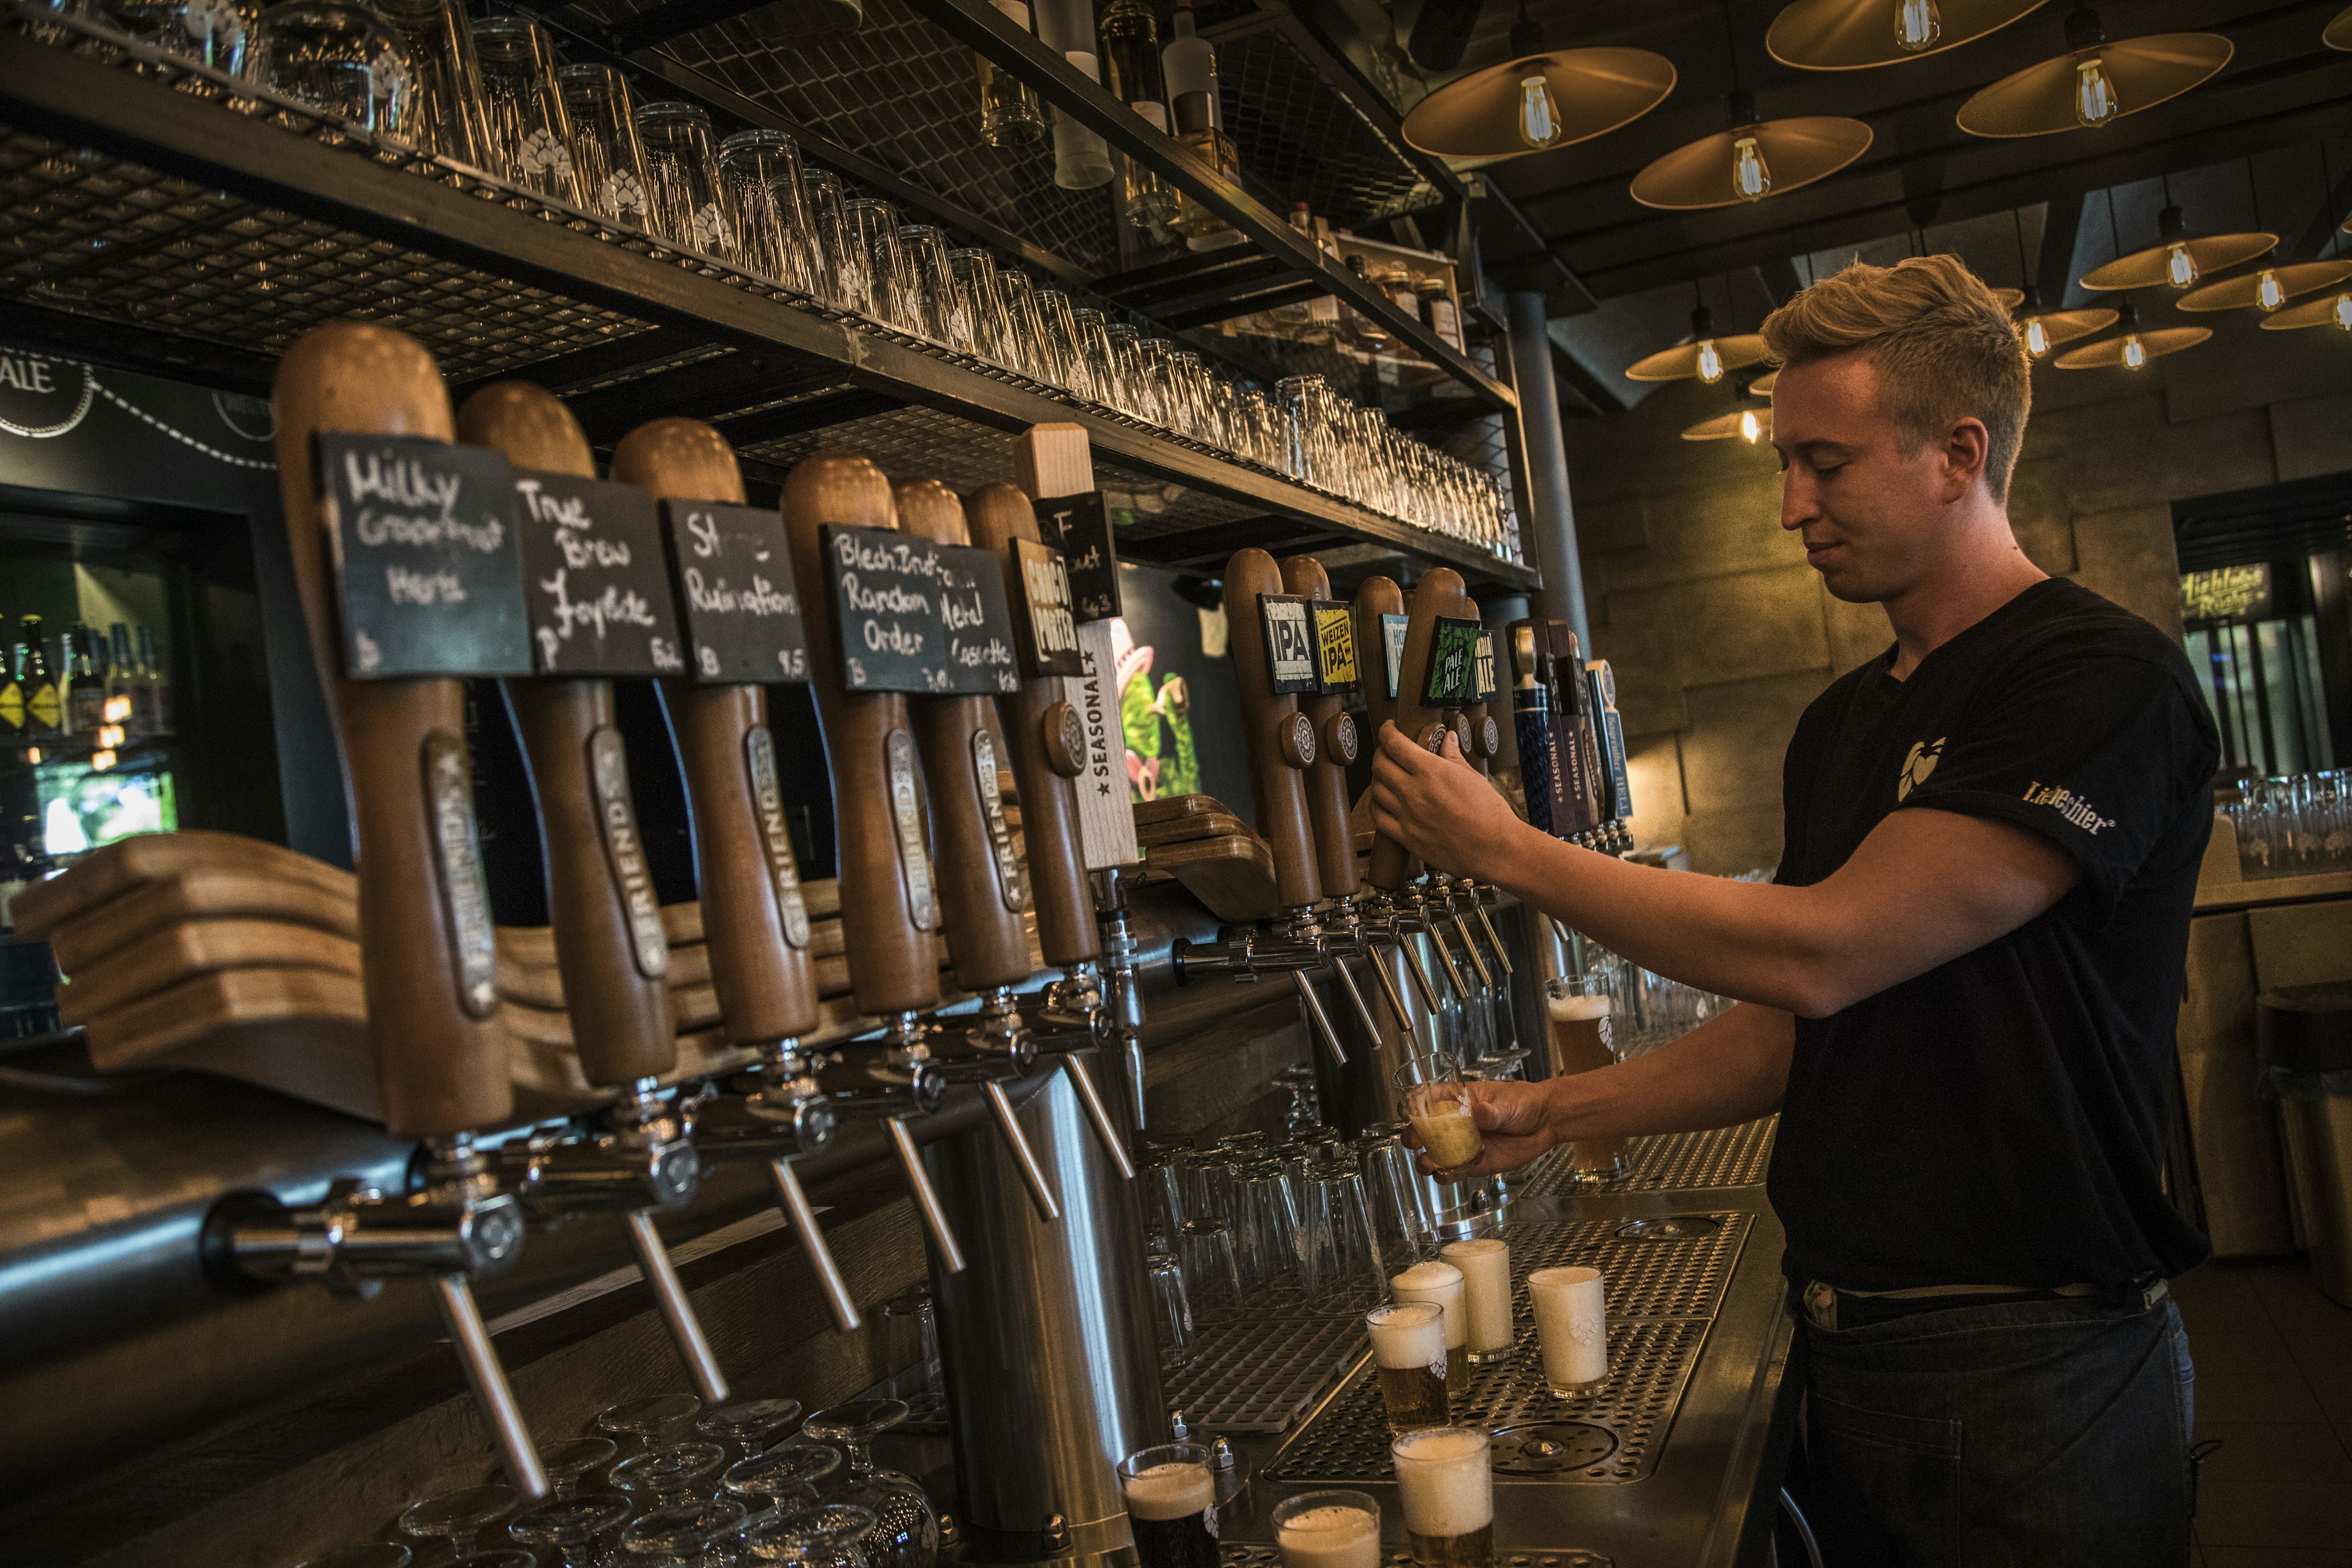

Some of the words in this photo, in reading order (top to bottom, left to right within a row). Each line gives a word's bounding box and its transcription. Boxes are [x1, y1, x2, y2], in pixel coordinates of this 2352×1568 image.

[0, 355, 56, 393] ALE
[516, 479, 592, 530] True
[842, 571, 931, 616] Random
[864, 619, 924, 657] Order
[1272, 620, 1309, 661] IPA
[1321, 622, 1349, 647] WEIZEN
[1324, 643, 1347, 677] IPA
[1445, 648, 1463, 674] PALE
[1477, 657, 1496, 694] ALE
[1443, 666, 1461, 695] ALE
[1083, 666, 1109, 777] SEASONAL
[1549, 739, 1563, 794] SEASONAL
[1569, 738, 1581, 792] SEASONAL
